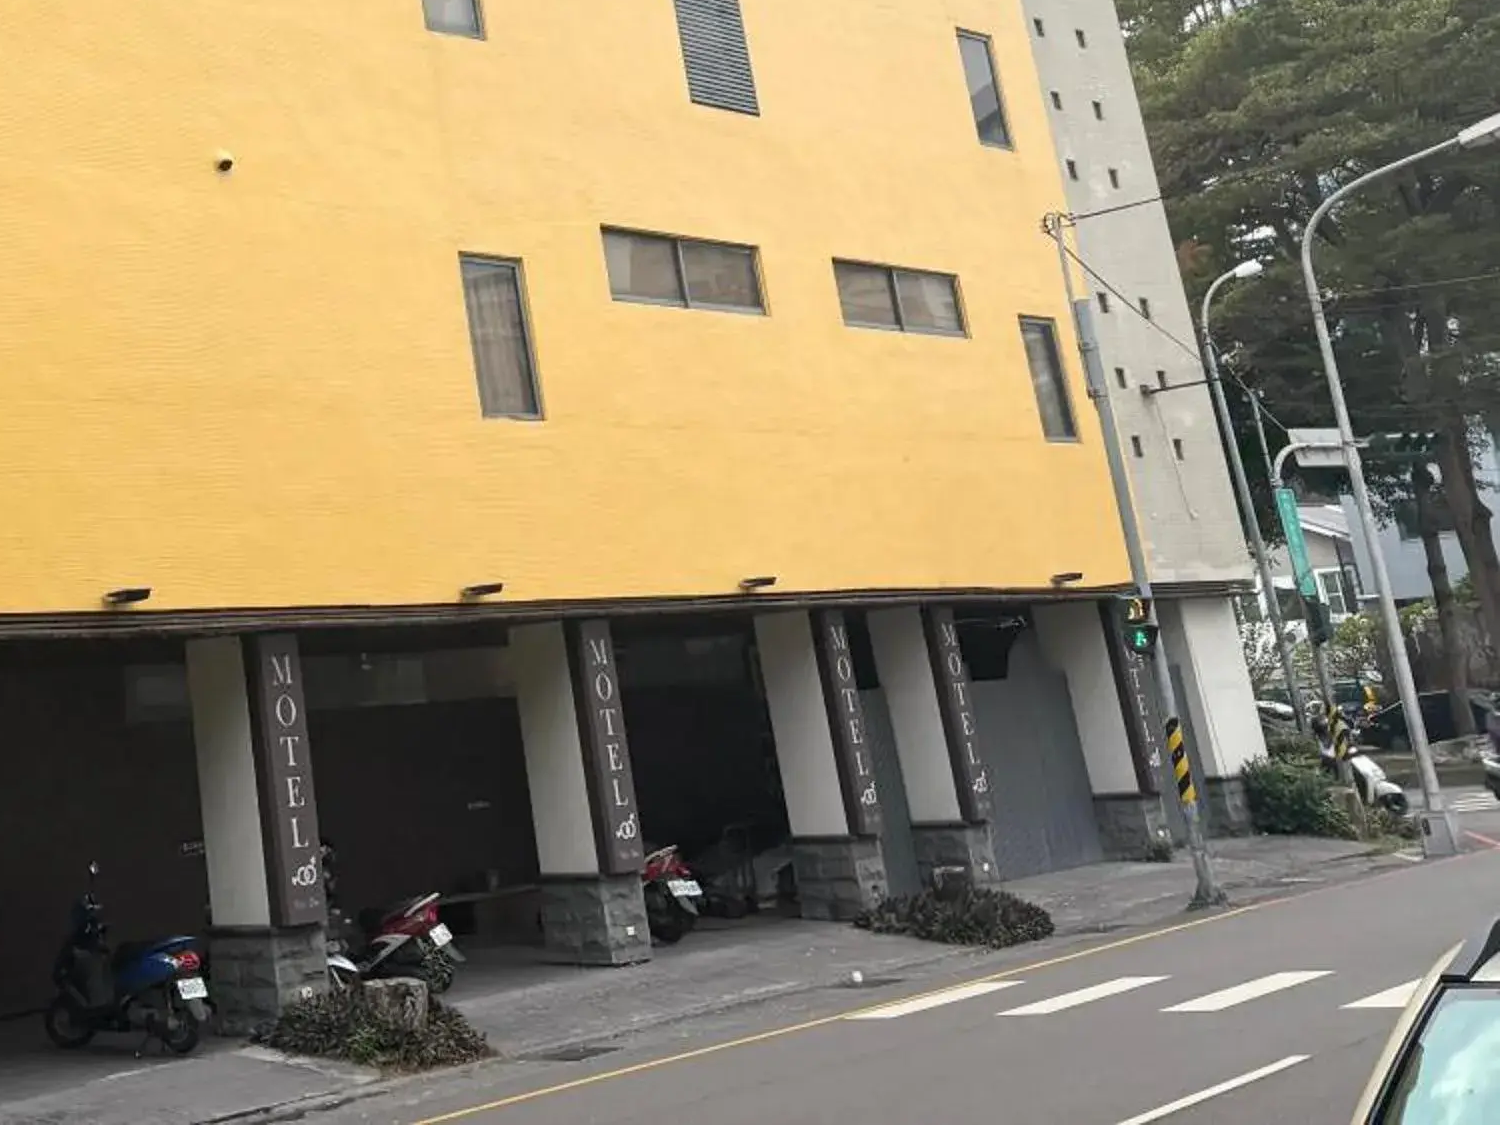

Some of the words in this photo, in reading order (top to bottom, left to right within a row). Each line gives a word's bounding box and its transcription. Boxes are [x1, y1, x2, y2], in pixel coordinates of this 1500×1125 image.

[271, 653, 309, 849] MOTEL
[589, 639, 628, 807] MOTEL
[830, 625, 868, 776] MOTEL
[941, 623, 981, 764] MOTEL
